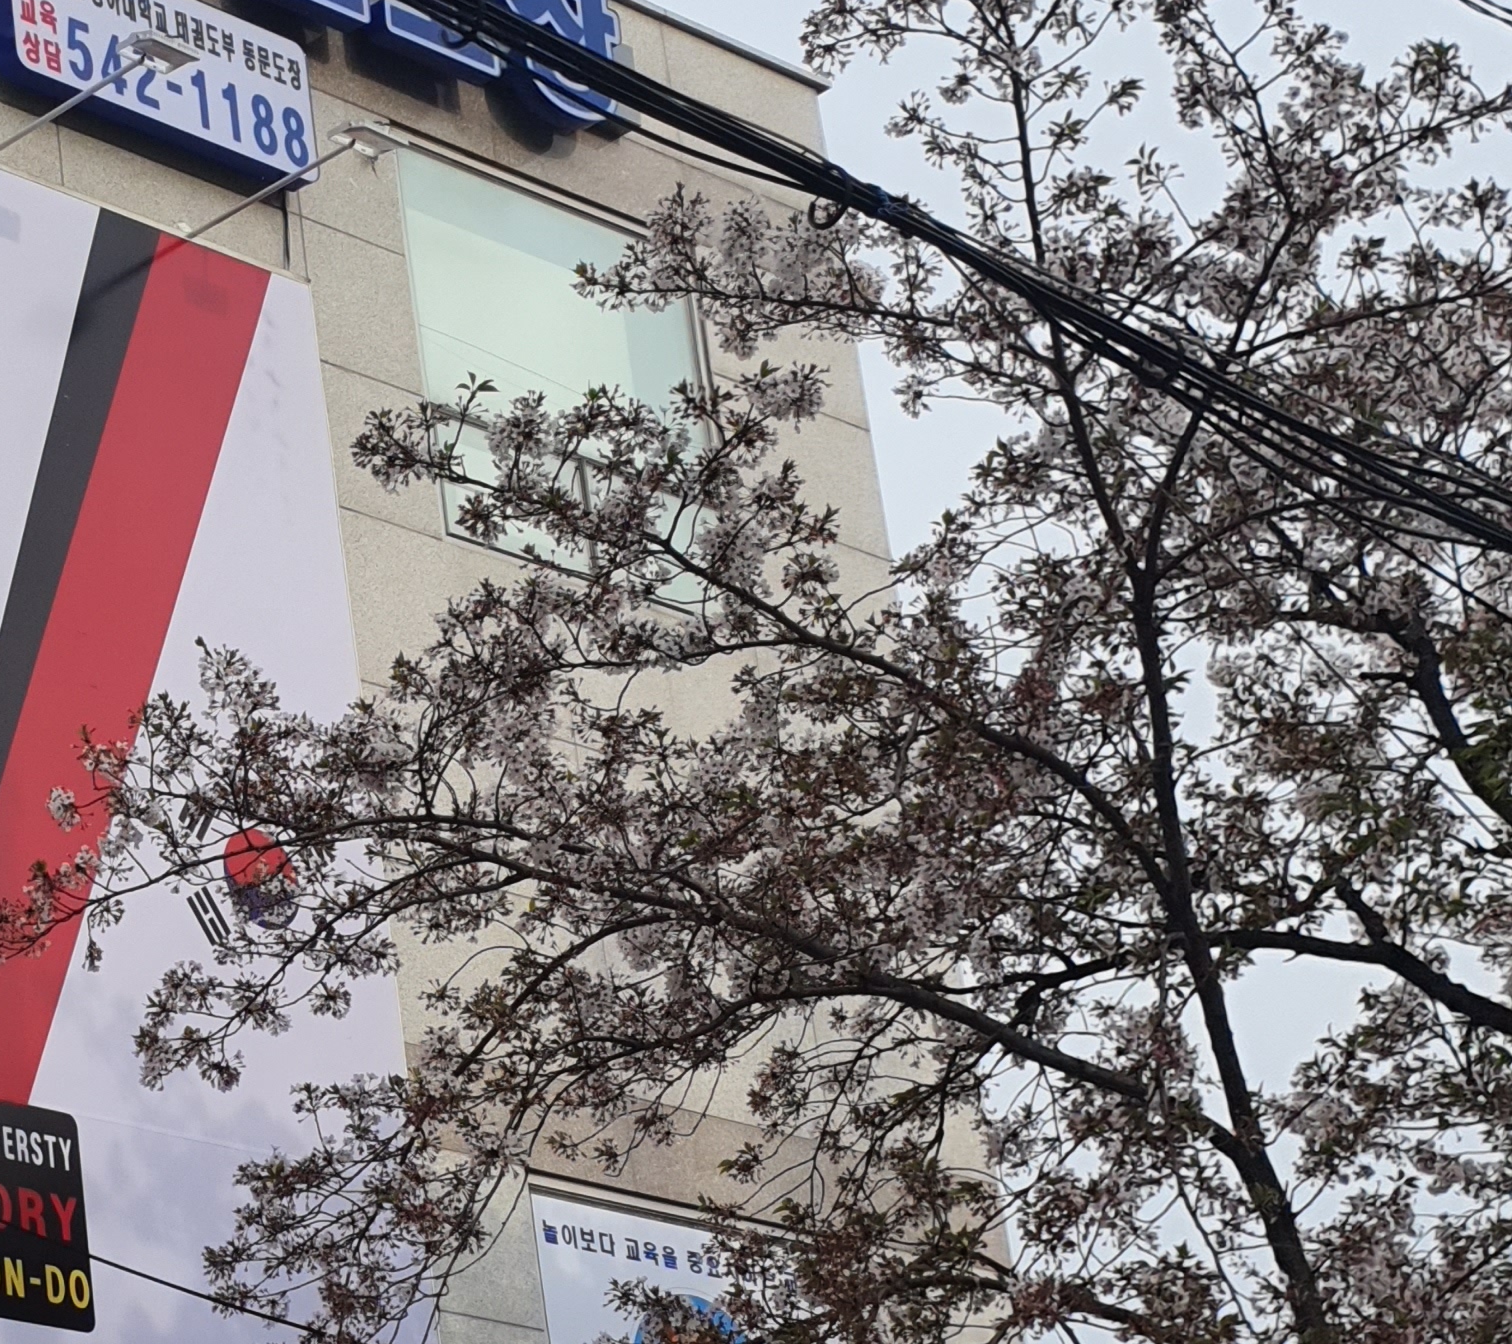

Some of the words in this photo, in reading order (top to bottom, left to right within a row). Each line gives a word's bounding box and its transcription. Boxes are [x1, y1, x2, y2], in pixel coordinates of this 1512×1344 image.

[22, 30, 62, 74] 상담
[175, 10, 236, 63] 태권도부
[242, 38, 302, 92] 동문도장
[66, 16, 310, 169] 542-1188
[624, 1237, 679, 1270] 교육을
